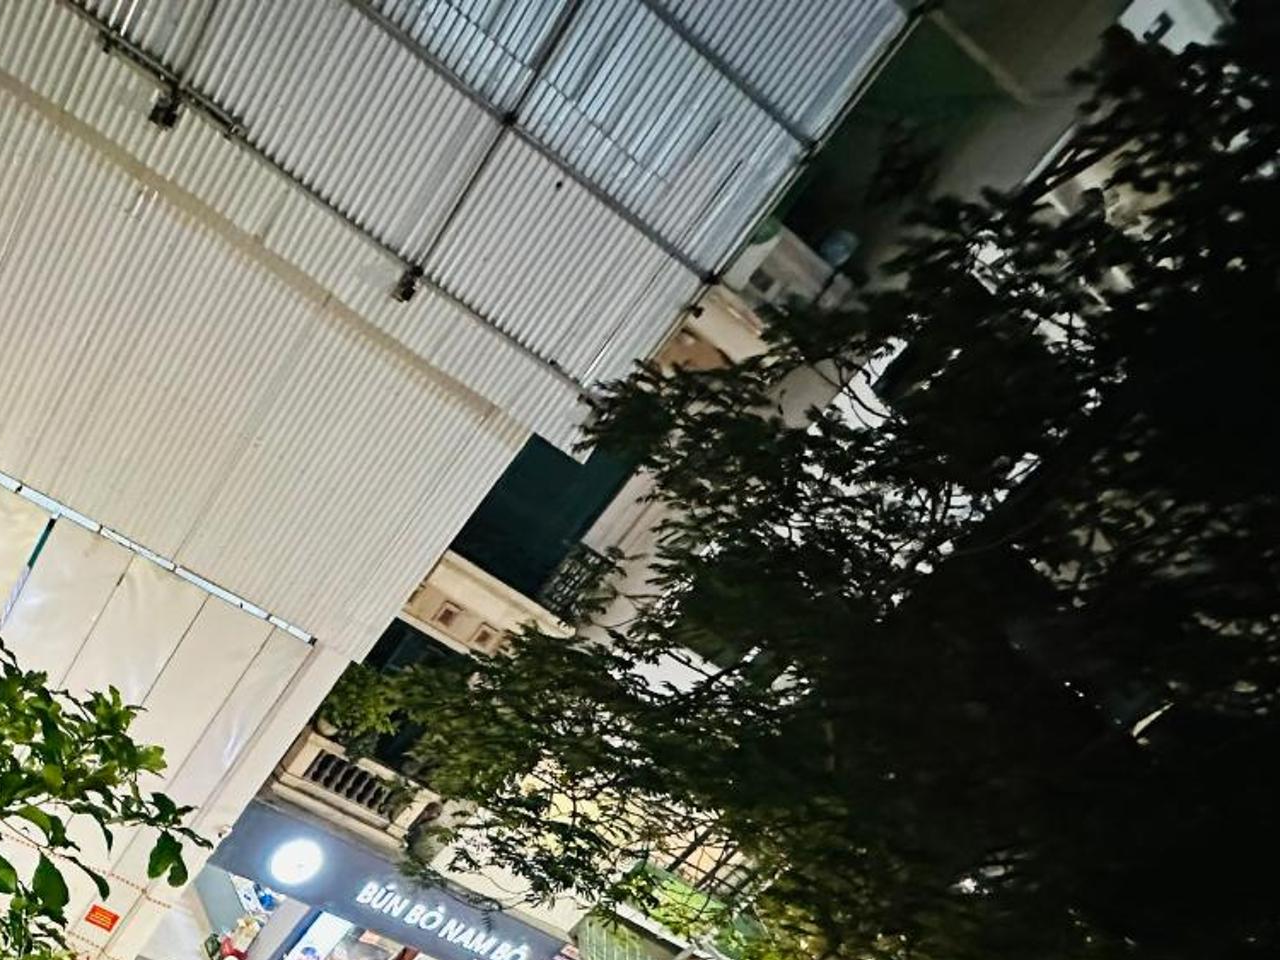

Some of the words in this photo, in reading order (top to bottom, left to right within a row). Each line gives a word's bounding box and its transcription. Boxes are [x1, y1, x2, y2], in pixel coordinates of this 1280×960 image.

[355, 880, 411, 919] BÚN
[403, 903, 447, 931] BÒ
[437, 917, 499, 956] NAM
